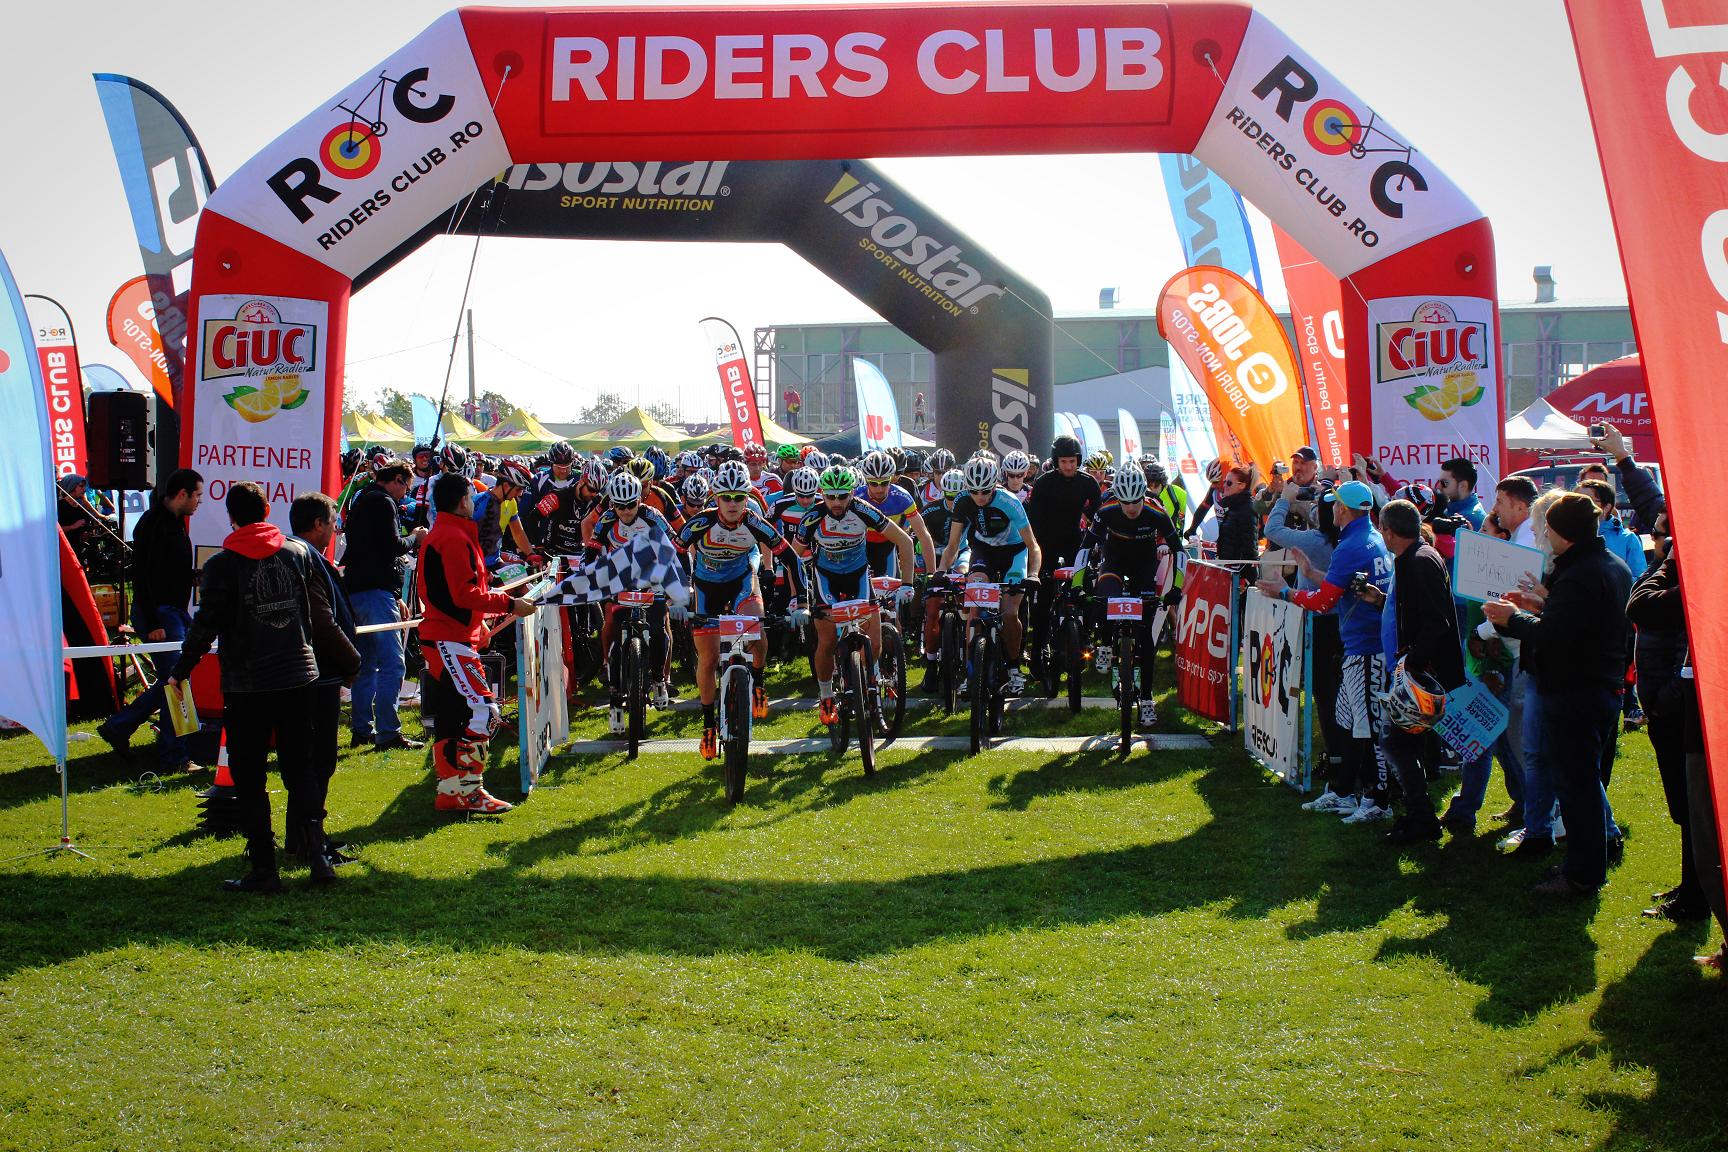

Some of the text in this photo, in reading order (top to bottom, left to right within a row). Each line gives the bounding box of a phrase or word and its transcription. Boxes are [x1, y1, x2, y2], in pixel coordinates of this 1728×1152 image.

[552, 27, 1165, 102] RIDERS CLUB
[1226, 105, 1297, 170] RIDERS
[560, 195, 715, 211] SPORT NUTRITION
[316, 189, 391, 251] RIDERS
[830, 182, 1005, 308] isostar
[859, 237, 962, 317] SPORT NUTRITION
[1569, 415, 1585, 423] din
[1590, 415, 1633, 425] pasiune
[198, 445, 312, 469] PARTENER
[1379, 444, 1490, 466] PARTENER
[975, 589, 990, 600] 15
[1118, 603, 1133, 613] 13
[735, 621, 744, 632] 9
[844, 606, 859, 617] 12
[1176, 595, 1229, 658] MPG
[1370, 654, 1385, 719] GIANT
[1375, 744, 1388, 782] GIANT
